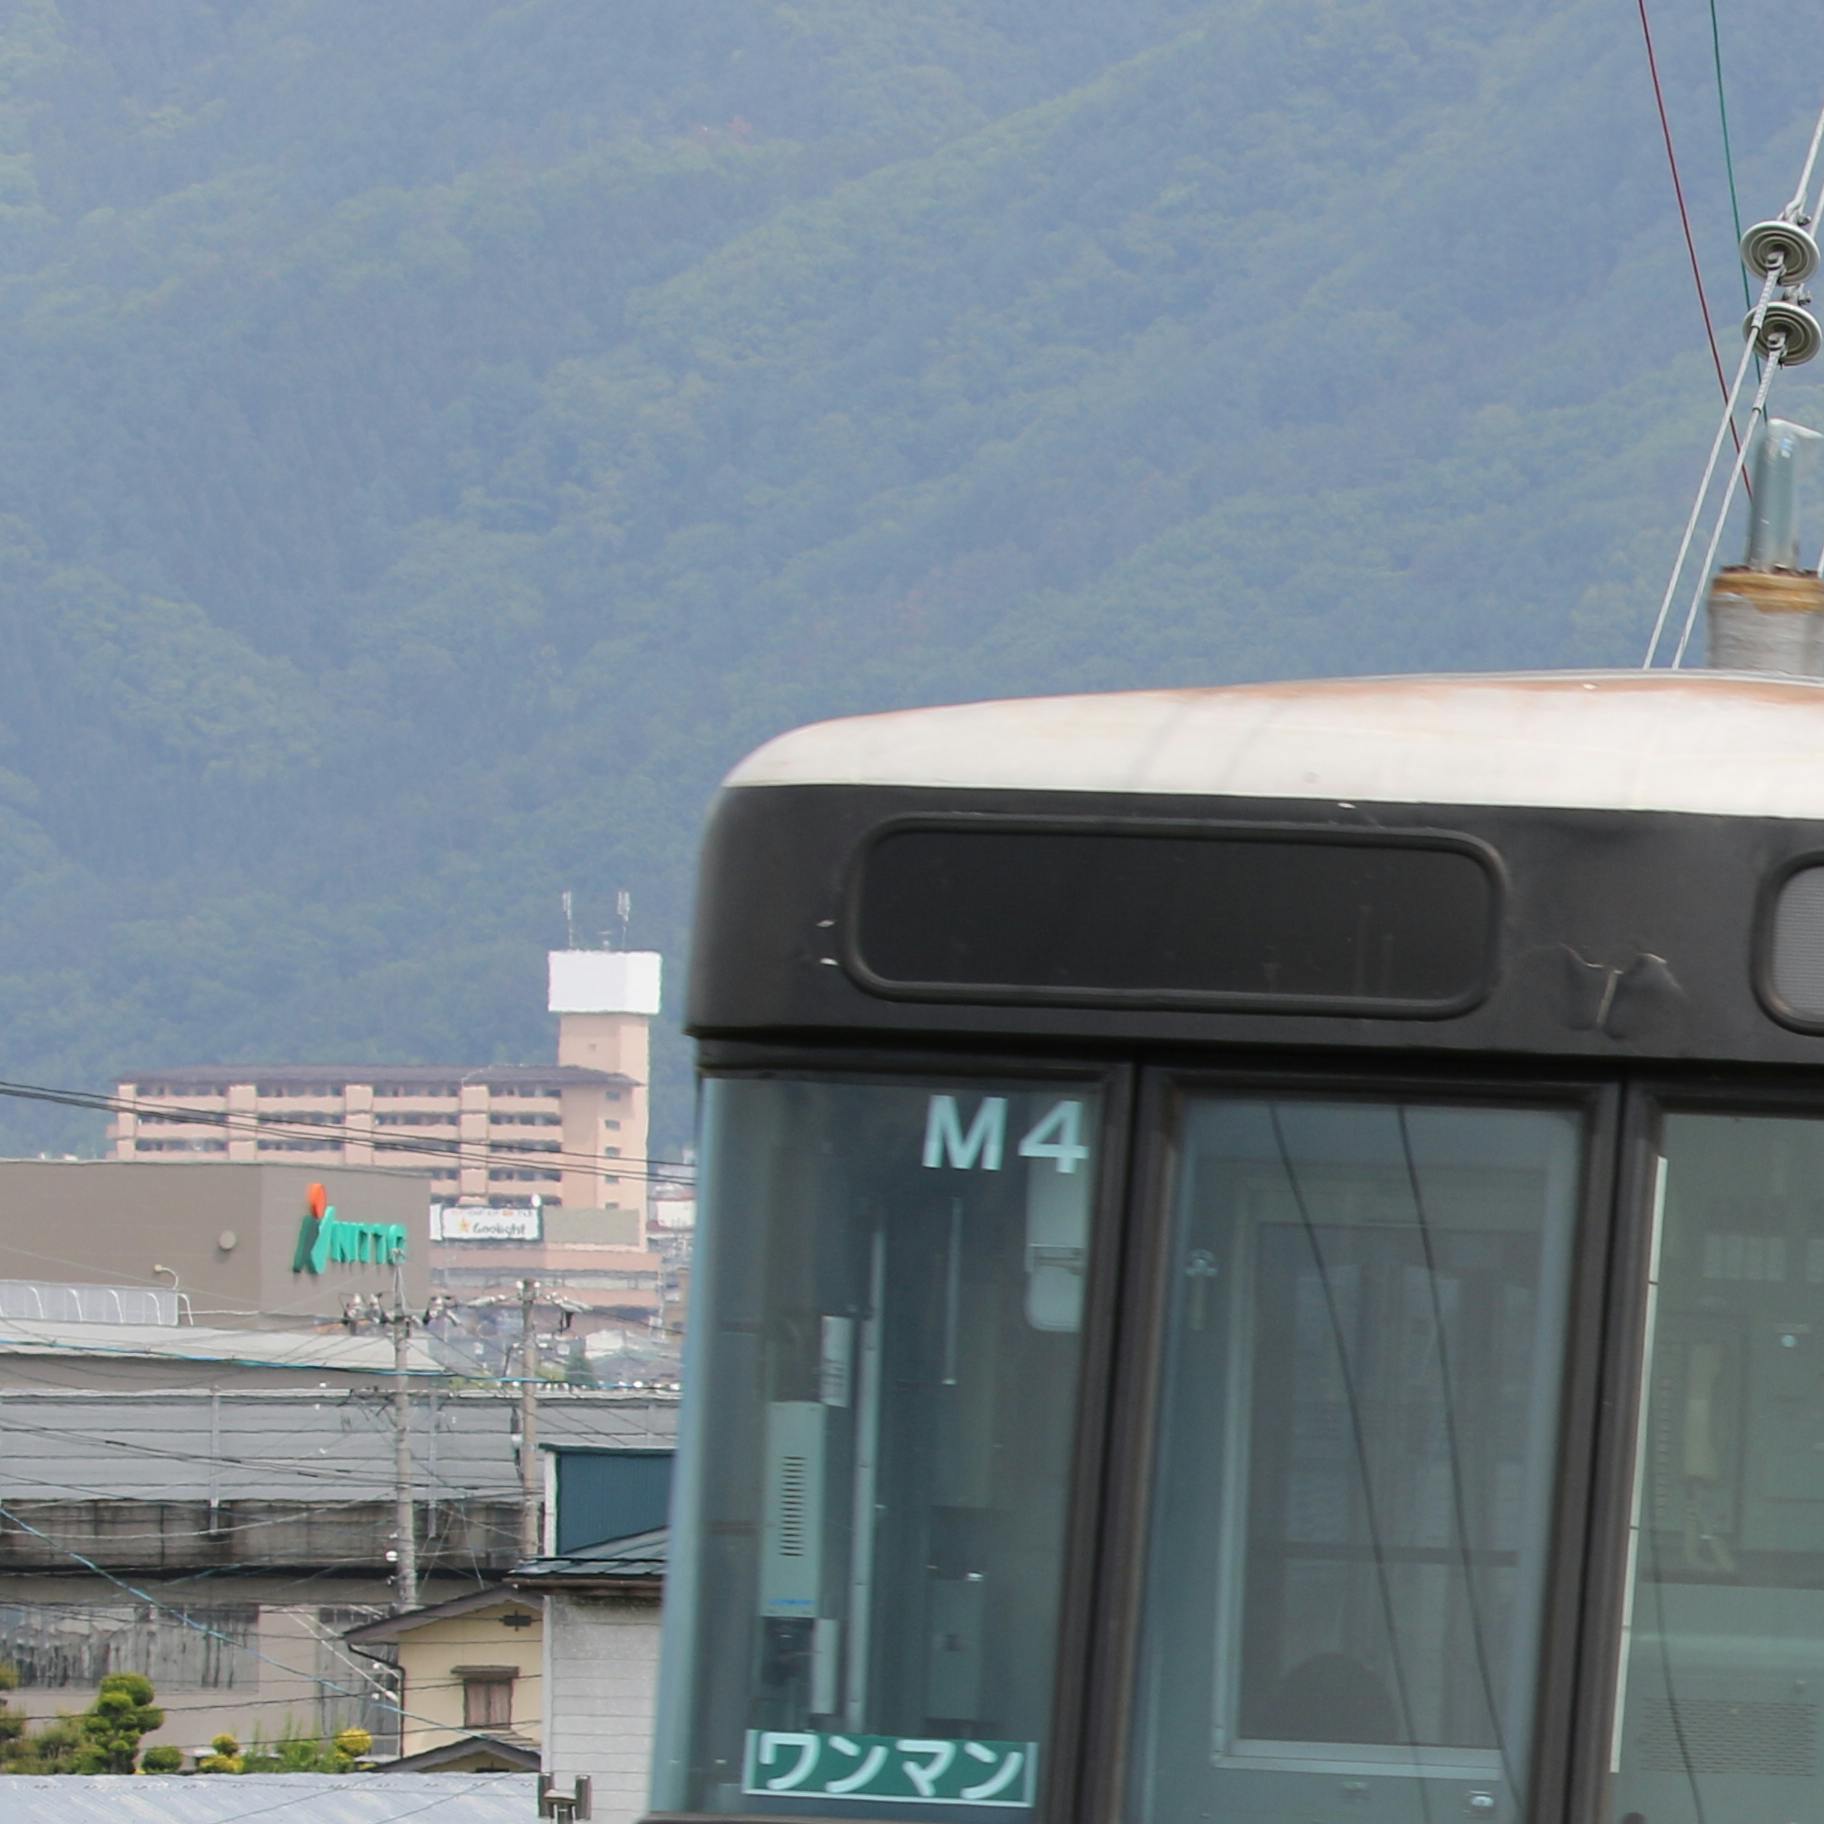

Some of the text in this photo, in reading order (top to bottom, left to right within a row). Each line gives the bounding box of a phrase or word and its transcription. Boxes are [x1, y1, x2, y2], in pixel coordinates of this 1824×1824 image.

[921, 1094, 1090, 1174] M4
[758, 1731, 1024, 1800] ワンマン
